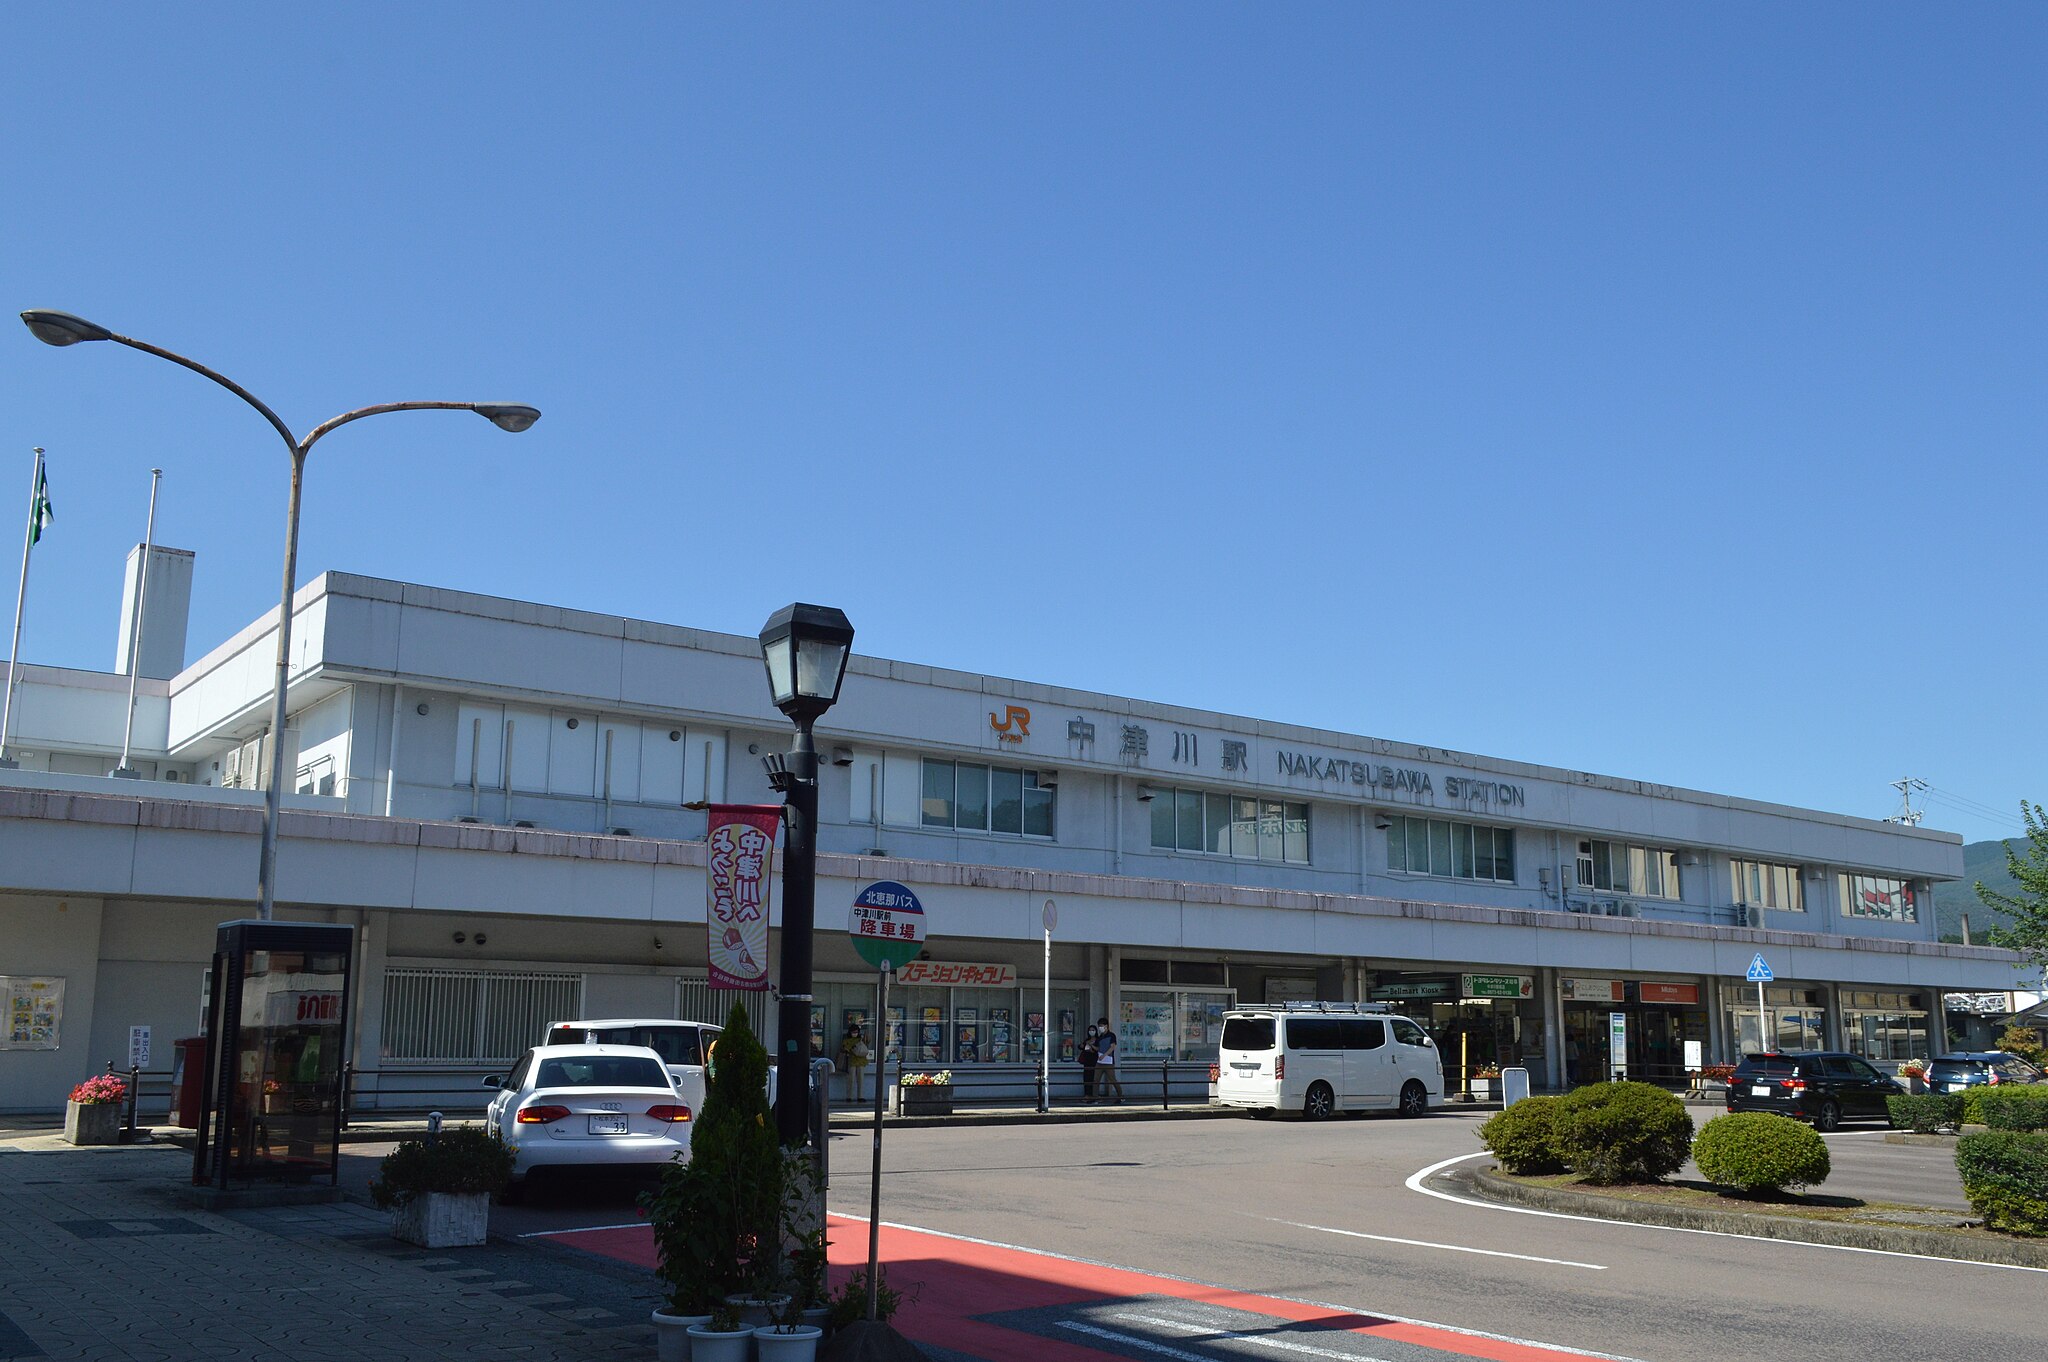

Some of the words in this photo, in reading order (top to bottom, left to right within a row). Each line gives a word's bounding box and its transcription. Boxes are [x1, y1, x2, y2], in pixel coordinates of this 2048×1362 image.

[989, 704, 1031, 737] JR
[1066, 715, 1249, 774] 中津川駅
[1276, 751, 1434, 797] NAKATSUGAWA
[1445, 776, 1525, 808] STATION
[866, 890, 913, 908] 北恵那バス
[853, 908, 892, 921] 中津川駅前
[860, 918, 916, 940] 降車場
[900, 963, 1015, 985] ステーションギャラリー
[1389, 987, 1419, 995] Bellmart
[1421, 986, 1440, 994] Kiosk
[613, 1122, 626, 1133] 33
